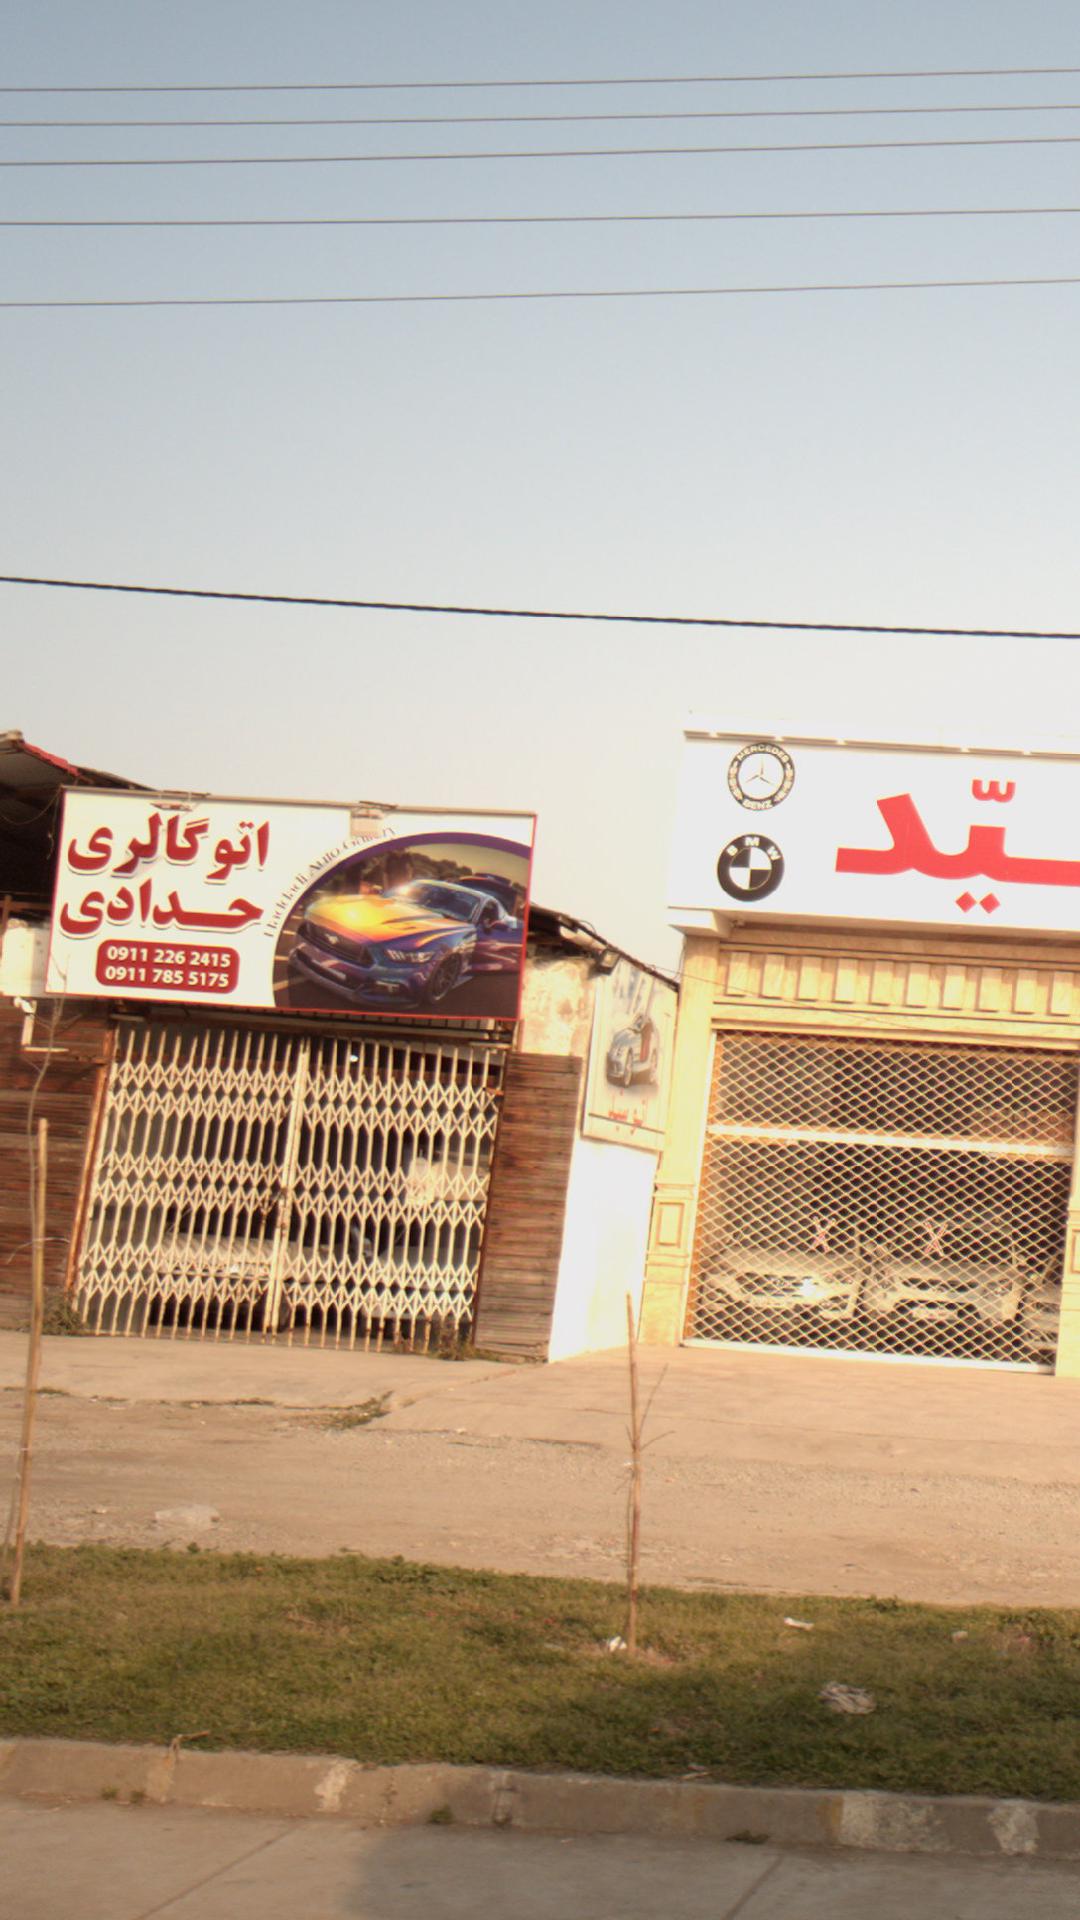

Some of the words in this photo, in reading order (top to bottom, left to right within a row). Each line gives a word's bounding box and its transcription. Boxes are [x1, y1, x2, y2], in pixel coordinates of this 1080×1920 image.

[726, 836, 782, 861] BMW
[60, 878, 263, 934] حدادی
[107, 945, 149, 962] 0911
[153, 949, 186, 965] 226
[189, 951, 231, 968] 2415
[105, 965, 146, 982] 0911
[152, 969, 184, 985] 785
[187, 971, 230, 988] 5175
